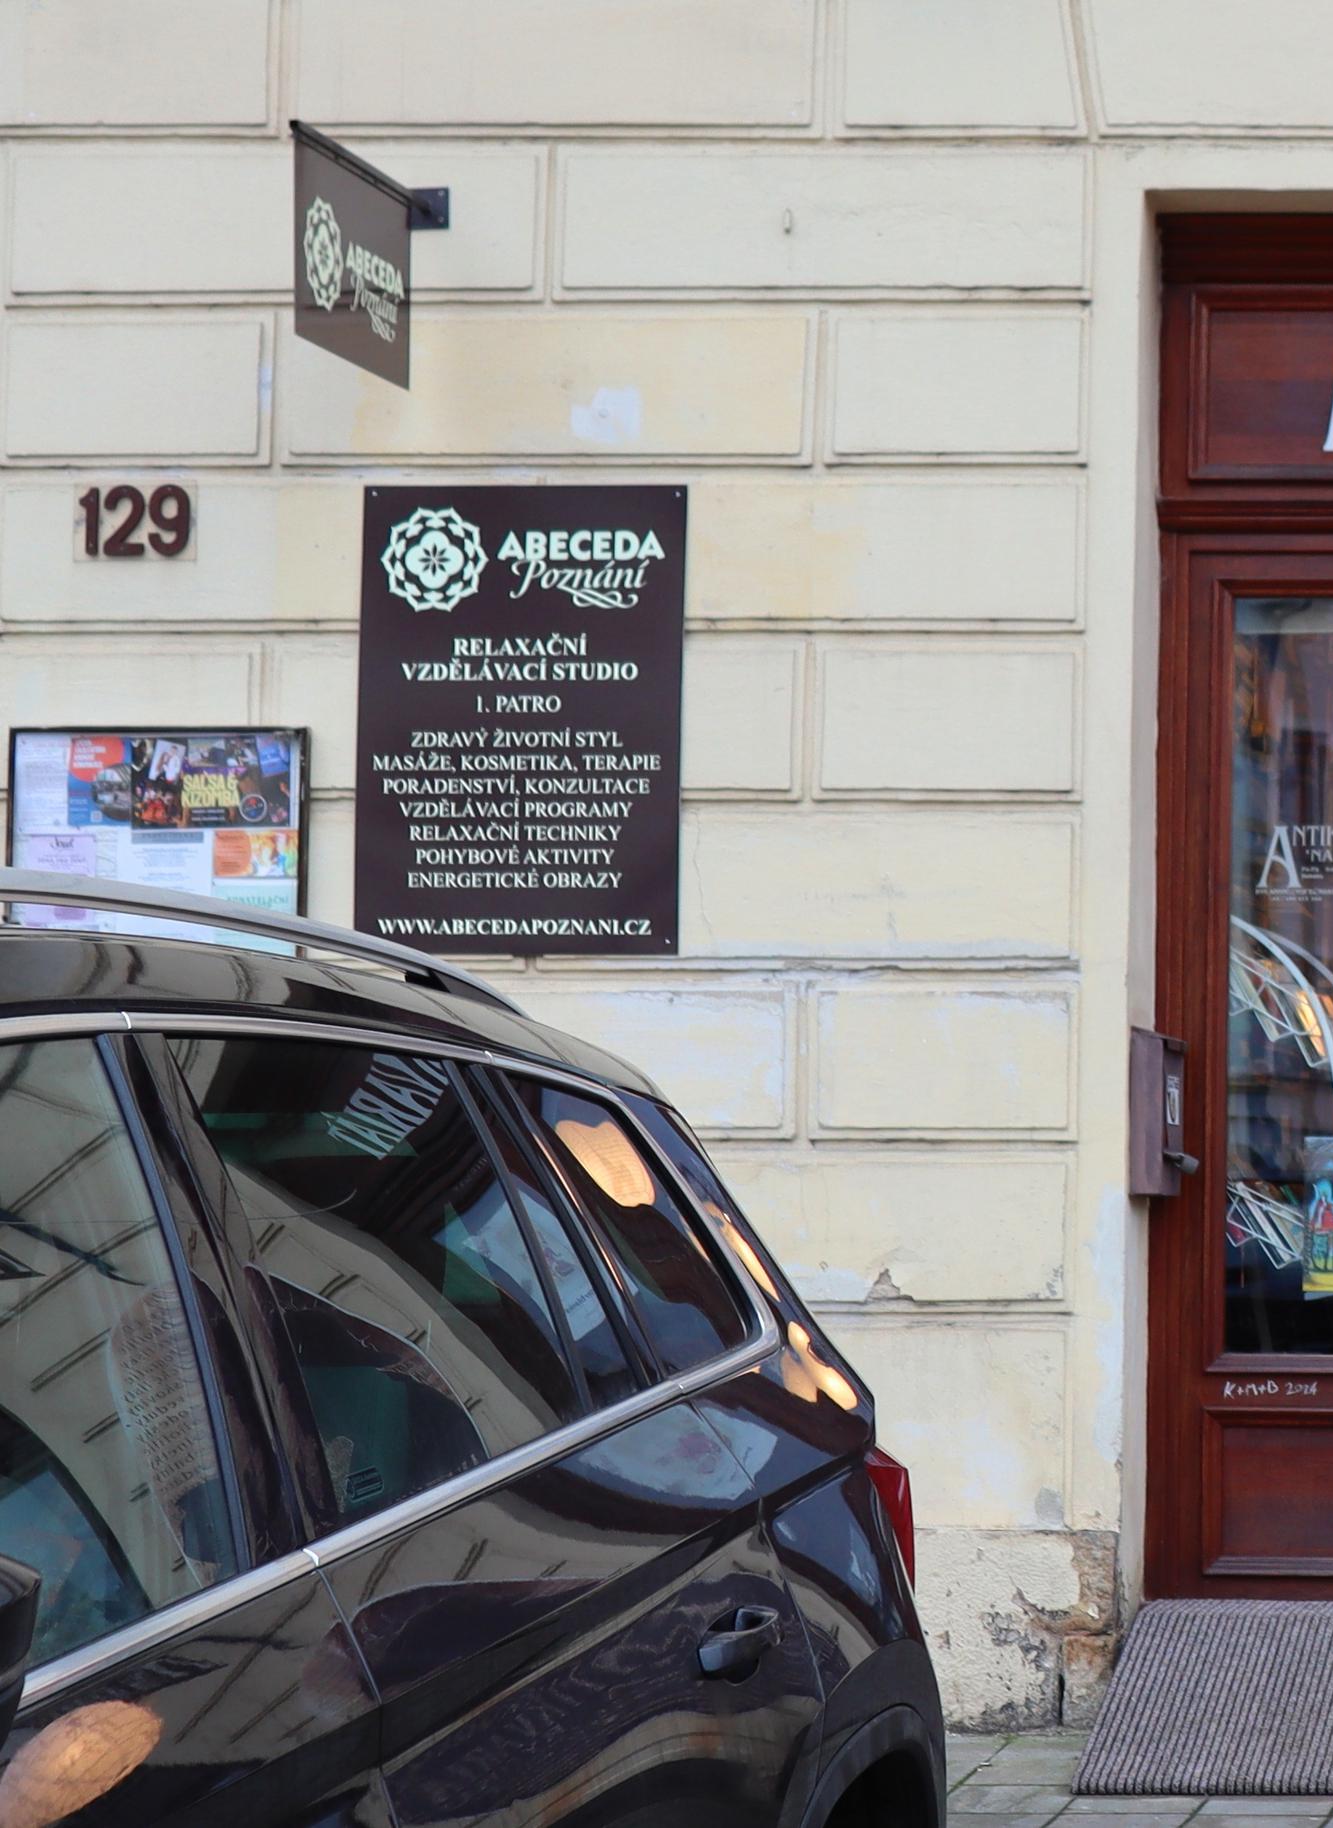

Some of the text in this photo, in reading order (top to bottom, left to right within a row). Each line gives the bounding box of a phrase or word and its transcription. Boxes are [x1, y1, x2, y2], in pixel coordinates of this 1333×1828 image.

[346, 240, 405, 299] ABECEDA
[79, 484, 191, 557] 129
[497, 530, 666, 561] ABECEDA
[509, 559, 650, 609] Poznání
[453, 633, 587, 656] RELAXAČNÍ
[401, 658, 639, 681] VZDĚLÁVACÍ STUDIO
[476, 695, 562, 713] 1. PATRO
[411, 728, 623, 748] ZDRAVÝ ŽIVOTNÍ STYL
[373, 751, 662, 773] MASÁŽE, KOSMETIKA, TERAPIE
[382, 774, 651, 796] PORADENSTVÍ, KONZULTACE
[400, 798, 634, 818] VZDĚLÁVACÍ PROGRAMY
[409, 821, 623, 842] RELAXAČNÍ TECHNIKY
[415, 845, 615, 865] POHYBOVÉ AKTIVITY
[407, 868, 623, 889] ENERGETICKÉ OBRAZY
[377, 918, 652, 936] WWW.ABECEDAPOZNANI.CZ
